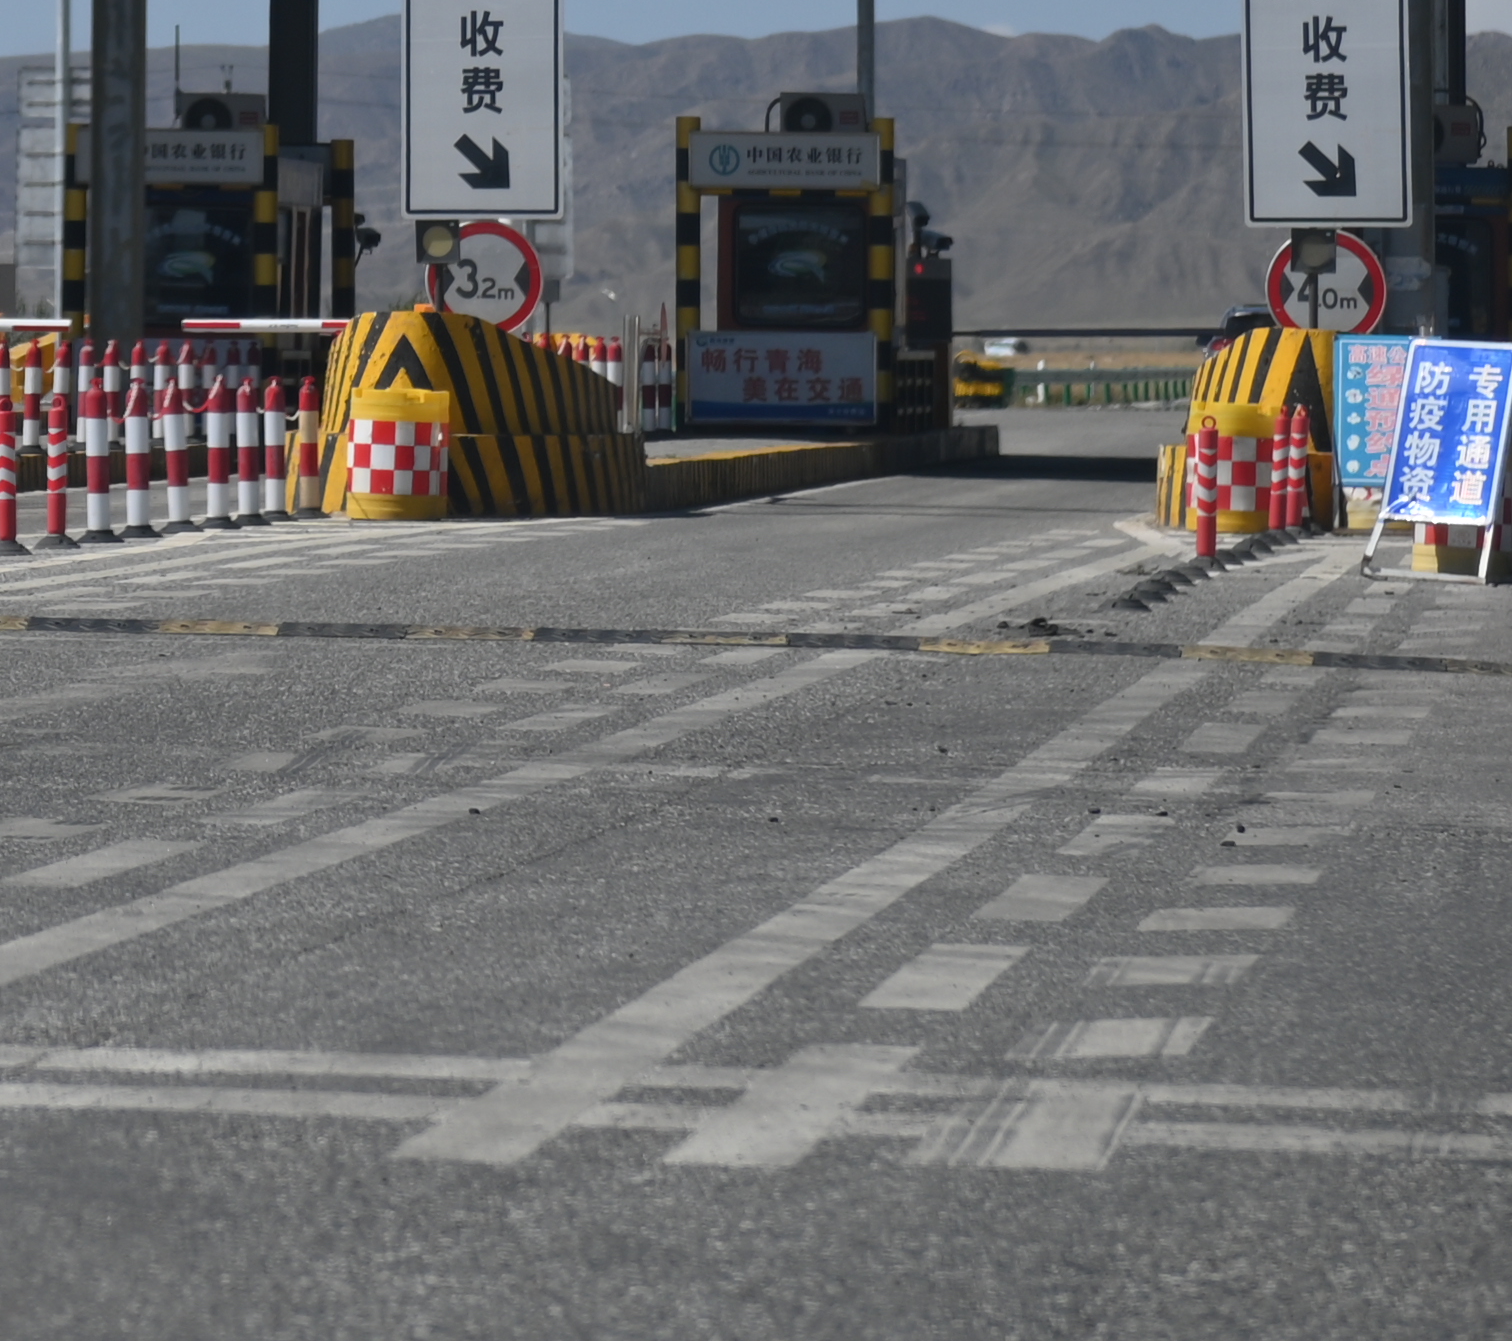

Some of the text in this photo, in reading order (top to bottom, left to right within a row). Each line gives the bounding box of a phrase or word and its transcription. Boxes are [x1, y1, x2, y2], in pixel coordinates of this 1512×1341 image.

[460, 10, 504, 115] 收费
[1302, 15, 1349, 122] 收费
[144, 143, 246, 160] 国农业银行
[747, 146, 863, 164] 中国农业银行
[455, 258, 515, 301] 3.2m
[702, 347, 823, 374] 畅行青海
[742, 376, 864, 403] 美在交通
[1398, 360, 1453, 501] 防疫物资
[1449, 363, 1504, 505] 专用通道
